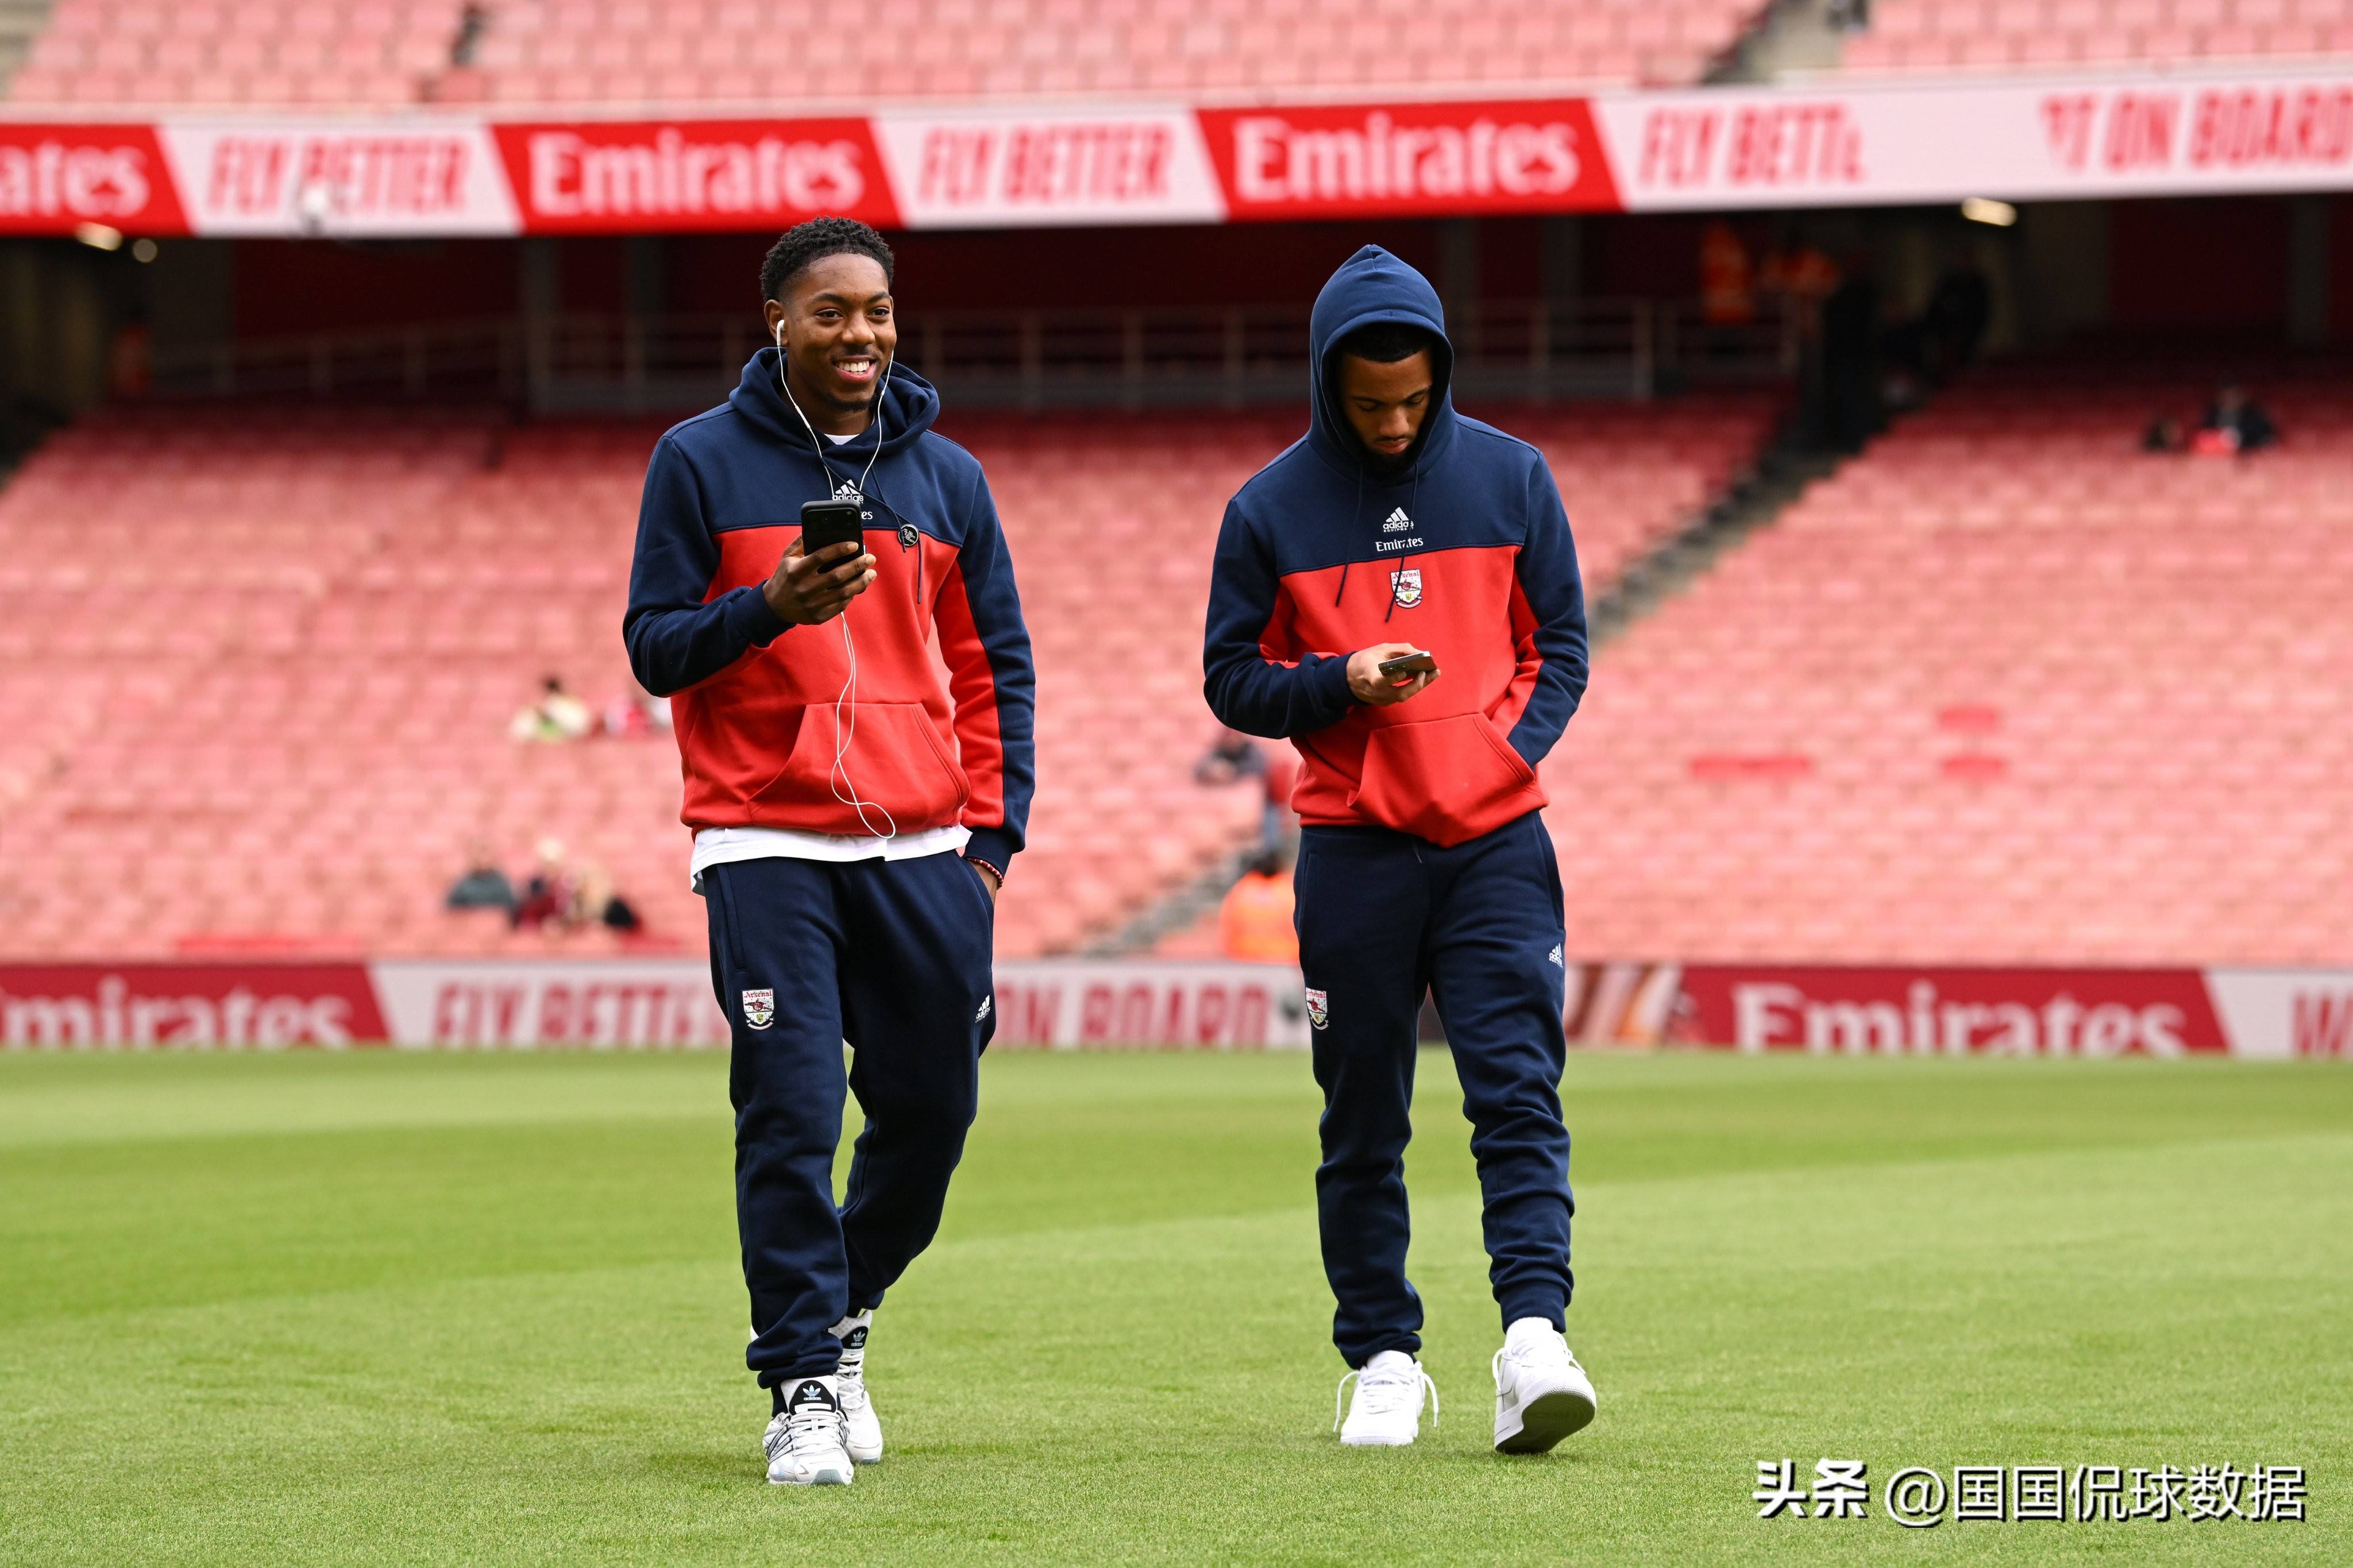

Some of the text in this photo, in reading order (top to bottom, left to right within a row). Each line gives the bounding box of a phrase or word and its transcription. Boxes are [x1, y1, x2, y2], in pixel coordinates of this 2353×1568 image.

[526, 125, 866, 218] Emirates
[1001, 122, 1173, 204] BETTER
[1233, 110, 1581, 203] Emirates
[832, 494, 864, 502] adidas
[1383, 520, 1414, 530] adidas
[1392, 570, 1419, 579] Asenal
[744, 990, 773, 998] Arsenal
[1731, 978, 2190, 1056] Emirates
